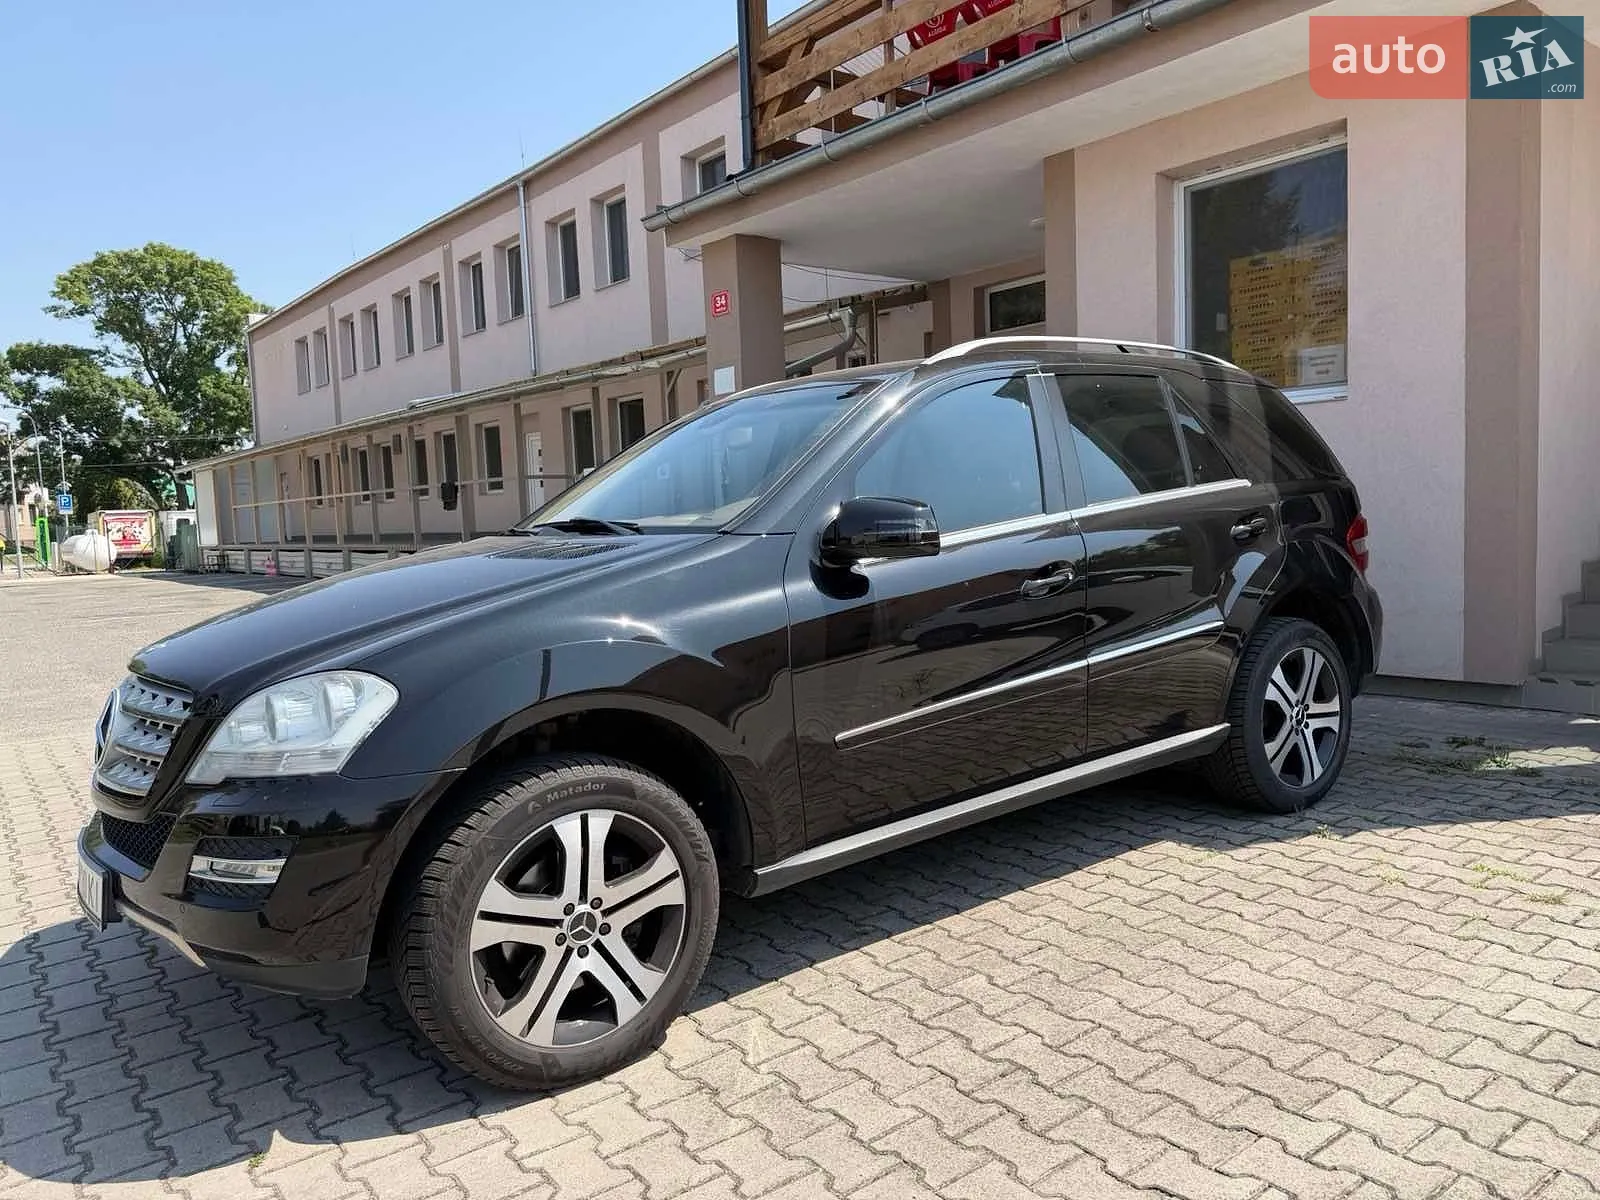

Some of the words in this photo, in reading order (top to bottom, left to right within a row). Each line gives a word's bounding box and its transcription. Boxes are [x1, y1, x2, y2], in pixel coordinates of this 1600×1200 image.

[715, 295, 726, 308] 34
[61, 497, 69, 506] P
[546, 781, 607, 803] Matador
